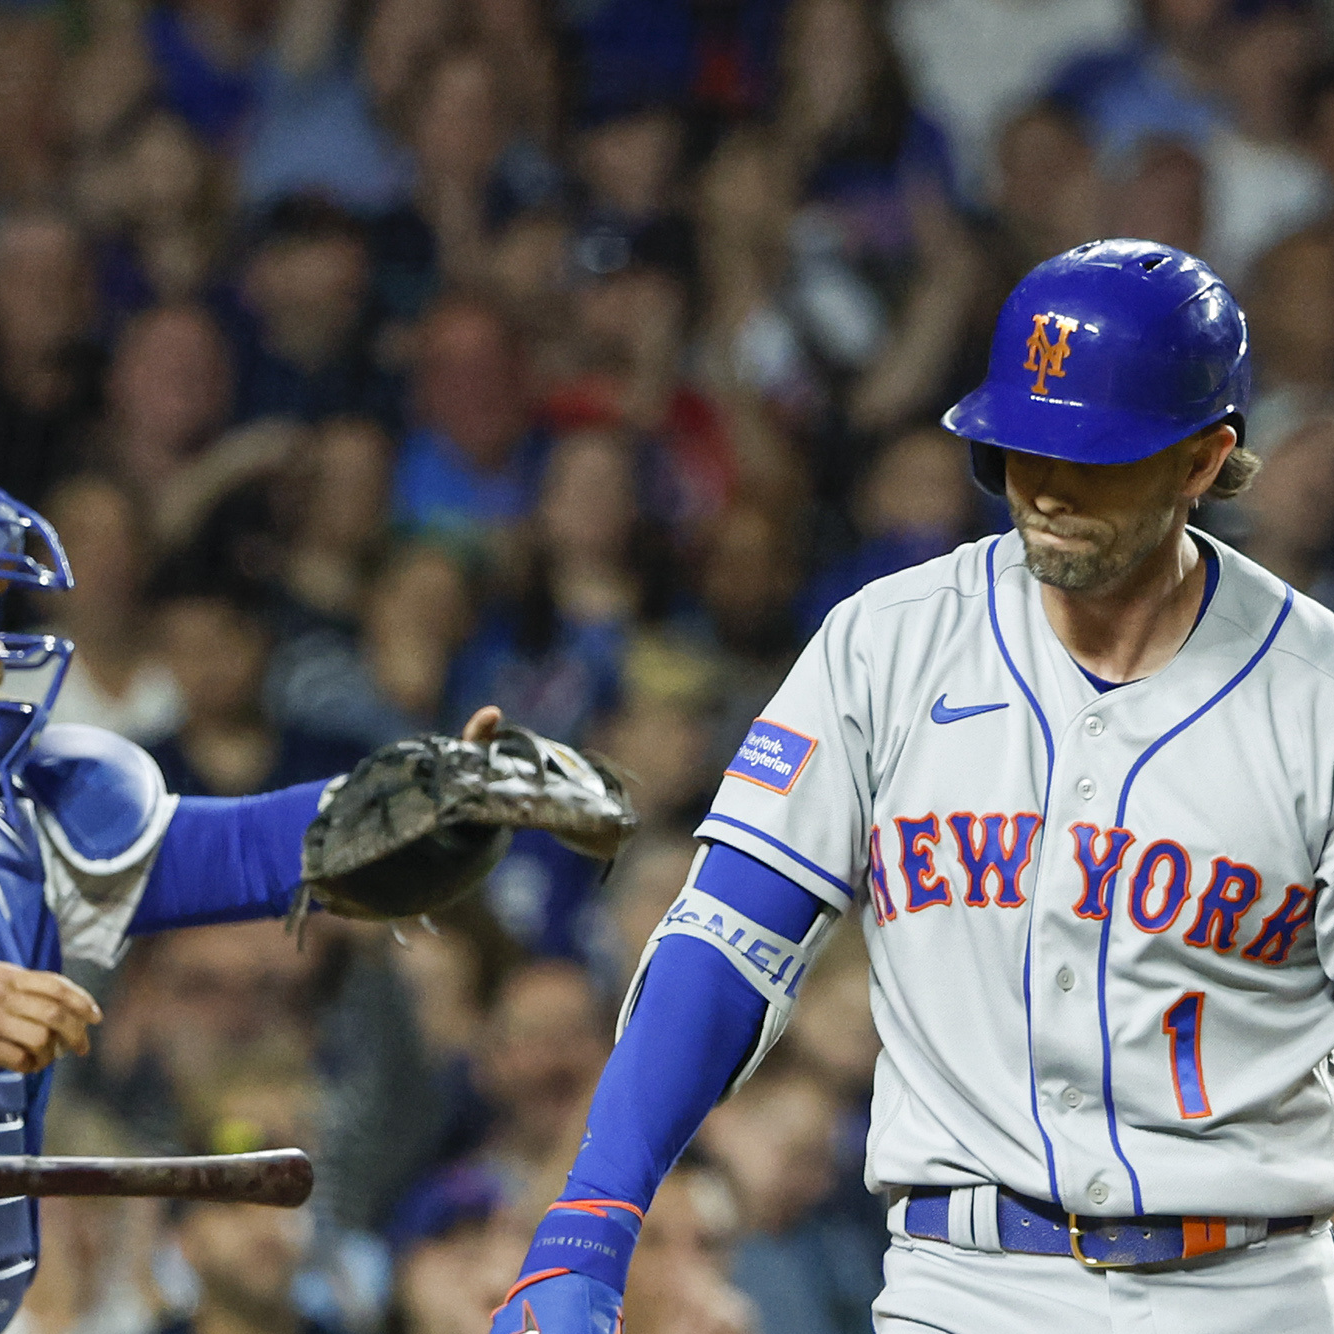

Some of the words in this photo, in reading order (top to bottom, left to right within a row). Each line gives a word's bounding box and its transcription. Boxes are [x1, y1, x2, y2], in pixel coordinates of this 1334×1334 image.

[870, 811, 1044, 927] NEW
[1068, 821, 1316, 965] YORK
[1162, 991, 1213, 1120] 1
